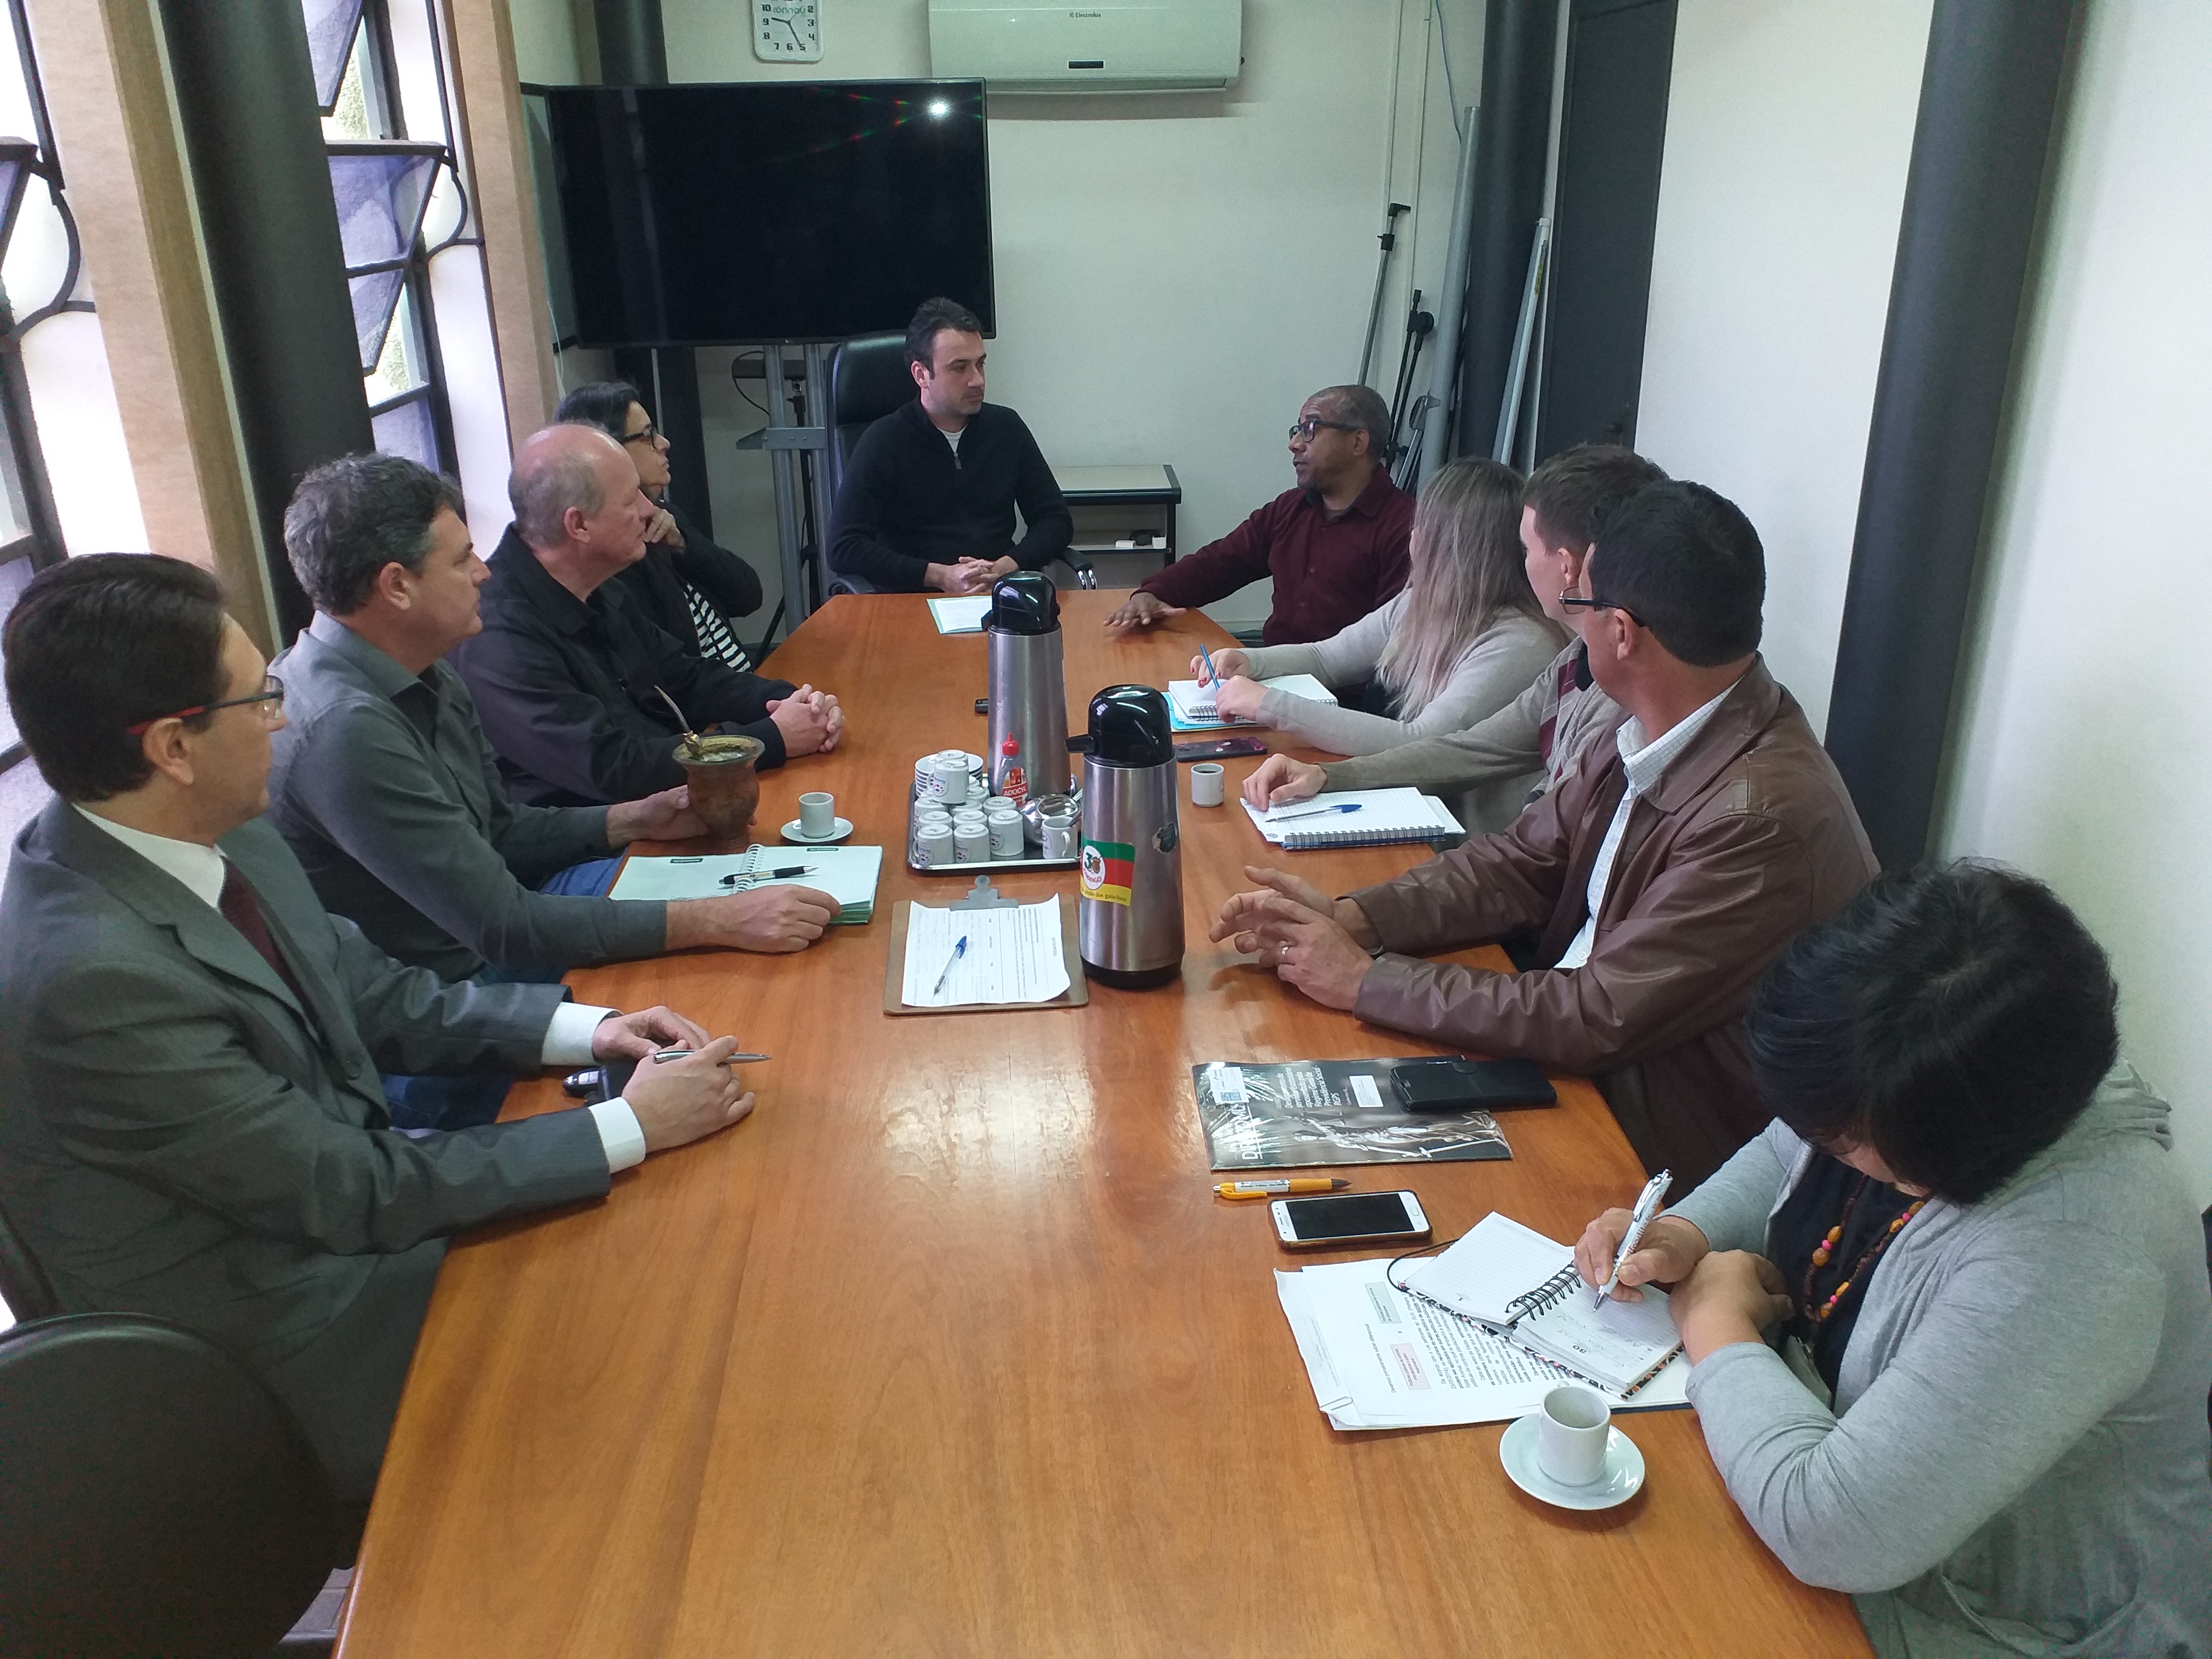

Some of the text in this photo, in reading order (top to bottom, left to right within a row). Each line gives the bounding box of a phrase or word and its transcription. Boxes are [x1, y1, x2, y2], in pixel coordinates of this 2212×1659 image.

[1004, 786, 1027, 796] ADOCYL
[1312, 1067, 1324, 1080] Social
[1306, 1078, 1317, 1089] Geral
[1291, 1090, 1303, 1108] servidor
[1310, 1089, 1322, 1107] Regime
[1318, 1080, 1332, 1106] Previdência
[1331, 1093, 1342, 1105] RGPS
[1421, 1319, 1430, 1331] público
[1448, 1333, 1462, 1352] populacional
[1485, 1341, 1494, 1354] controle
[1434, 1346, 1443, 1361] recursos
[1444, 1351, 1454, 1368] aplicados
[1459, 1353, 1468, 1366] controle
[1435, 1364, 1443, 1377] acordo
[1510, 1361, 1525, 1383] transmissão
[1529, 1362, 1539, 1376] Deve-se
[1541, 1370, 1549, 1380] saúde
[1548, 1370, 1556, 1380] saúde
[1455, 1376, 1464, 1388] podem
[1468, 1373, 1478, 1387] políticas
[1492, 1369, 1502, 1385] humanos
[1500, 1370, 1510, 1384] medidas
[1523, 1372, 1531, 1381] saúde
